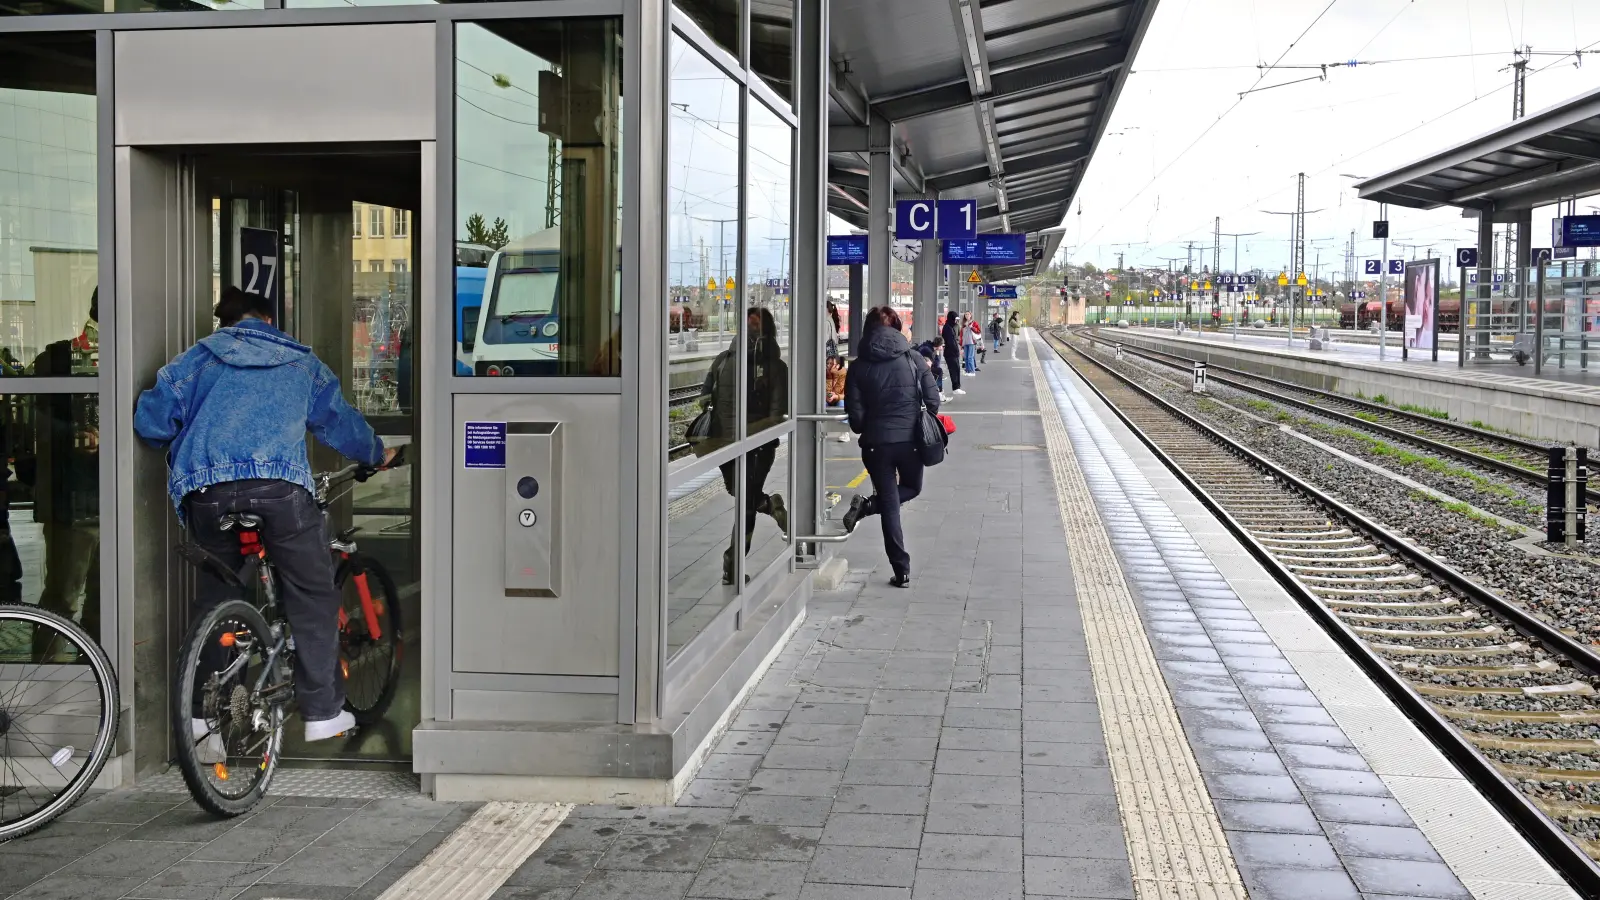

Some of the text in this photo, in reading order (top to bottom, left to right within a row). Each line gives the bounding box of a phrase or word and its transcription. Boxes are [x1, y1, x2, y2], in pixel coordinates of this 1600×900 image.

[910, 203, 930, 231] C
[960, 203, 971, 231] 1
[1460, 249, 1470, 264] C
[1367, 260, 1375, 272] 2
[1395, 260, 1402, 272] 3
[244, 253, 277, 300] 27
[1496, 274, 1502, 282] D
[992, 285, 996, 294] 1
[1194, 369, 1205, 384] H
